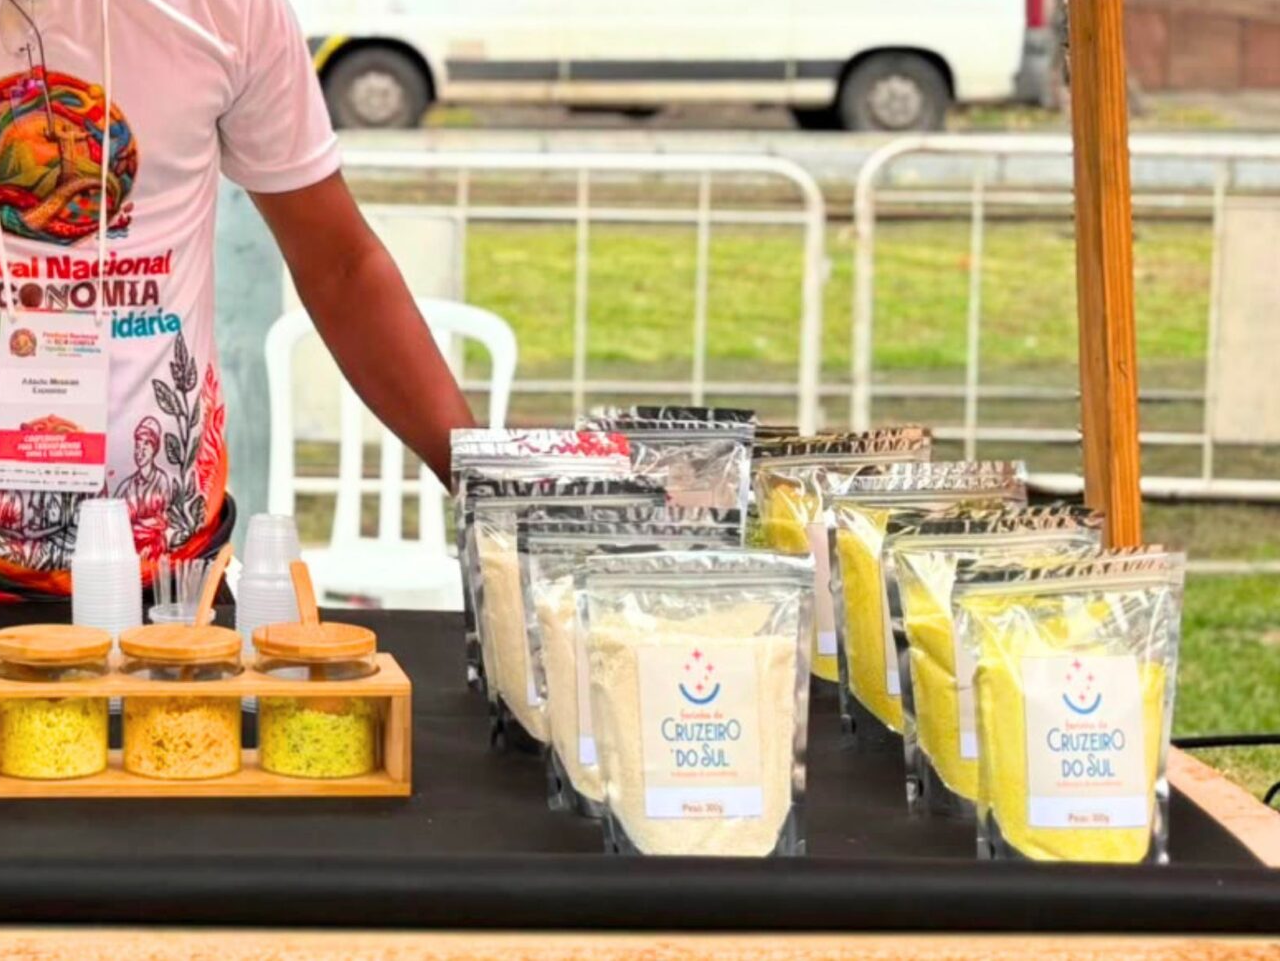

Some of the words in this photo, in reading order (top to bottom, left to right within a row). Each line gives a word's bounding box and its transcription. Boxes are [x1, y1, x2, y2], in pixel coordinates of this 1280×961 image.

[46, 249, 172, 280] Nacional
[111, 307, 181, 339] idária
[661, 717, 741, 741] CRUZEIRO
[1047, 727, 1126, 752] CRUZEIRO
[676, 748, 699, 767] DO
[700, 742, 730, 767] SUL
[1062, 758, 1084, 778] DO
[1086, 753, 1116, 778] SUL
